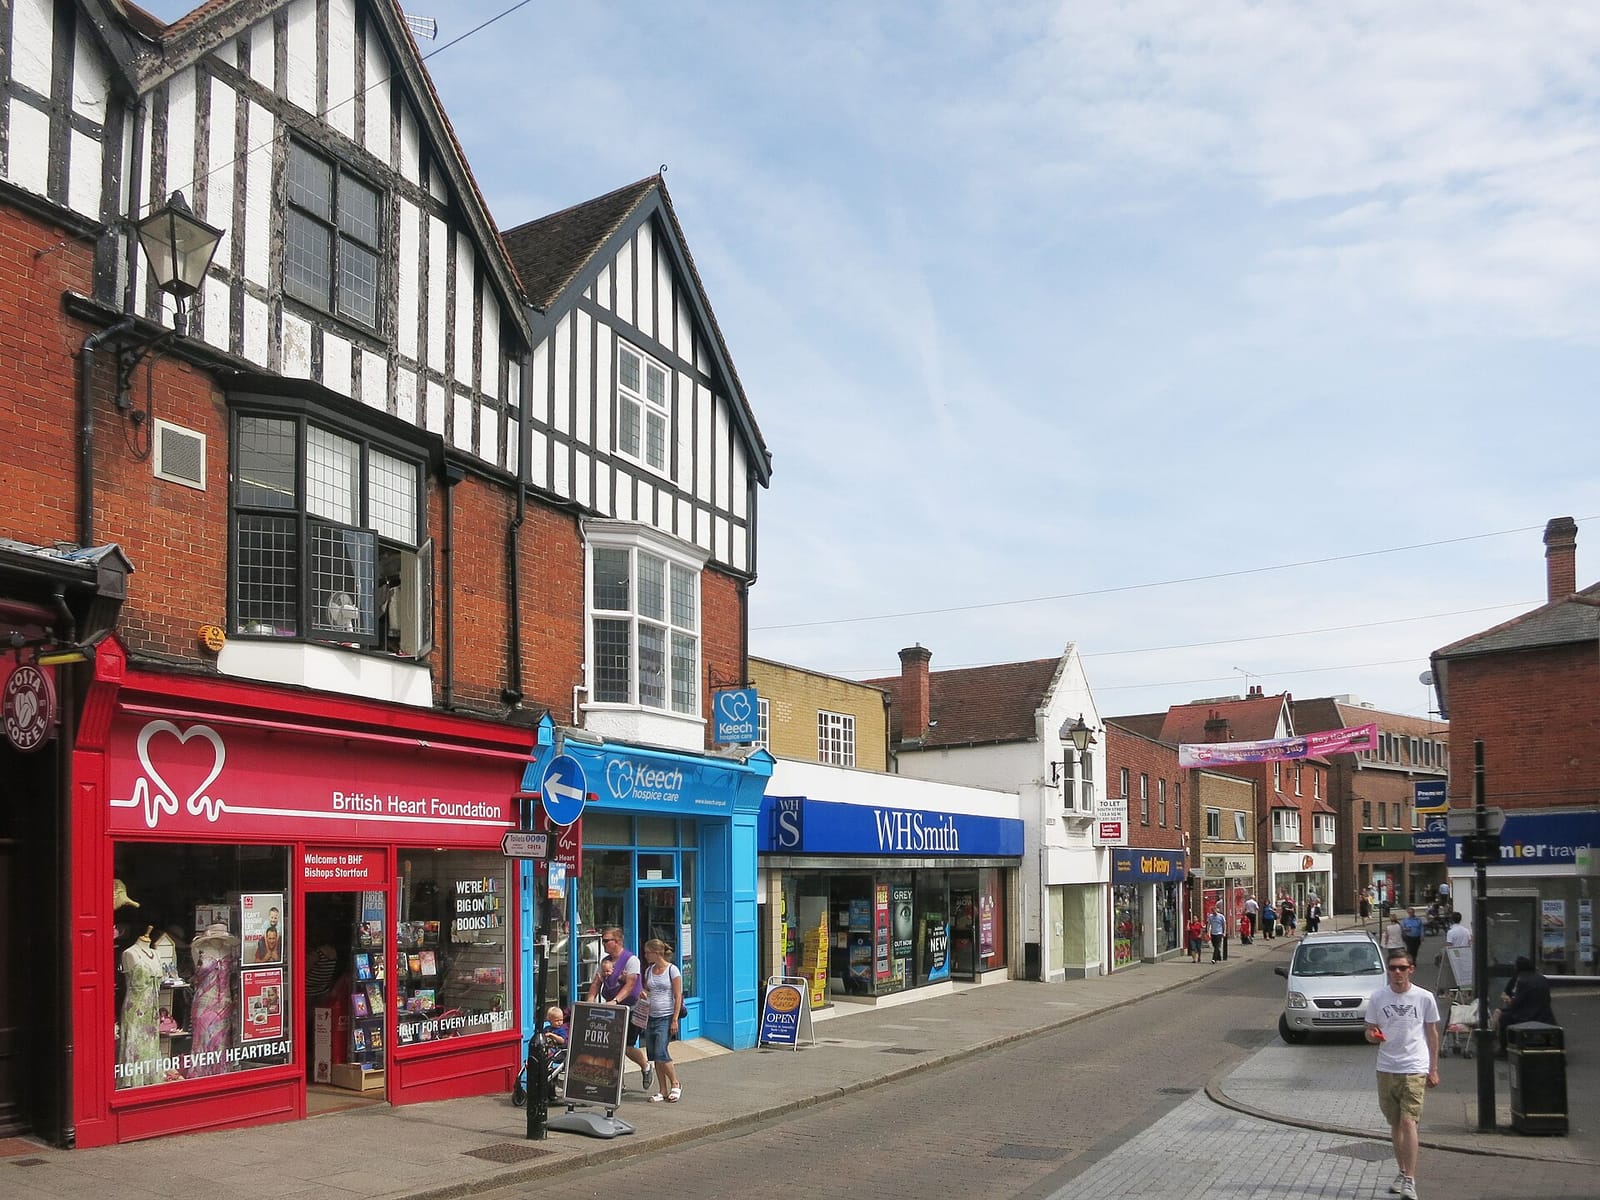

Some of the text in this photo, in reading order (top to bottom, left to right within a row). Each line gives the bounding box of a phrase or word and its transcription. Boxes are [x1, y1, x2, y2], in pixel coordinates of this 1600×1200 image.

[9, 669, 41, 694] COSTA
[7, 716, 46, 746] COFFEE
[719, 721, 753, 734] Keech
[634, 762, 683, 791] Keech
[632, 789, 679, 802] hospice care
[333, 791, 501, 818] British Heart Foundation
[780, 799, 799, 811] WH
[779, 811, 800, 846] S
[874, 809, 959, 851] WHSmith
[510, 834, 526, 842] Toilets
[304, 854, 363, 865] Welcome to BHF
[1141, 856, 1153, 874] Card
[1153, 856, 1170, 876] Factory
[304, 867, 368, 879] Bishops Stortford
[456, 880, 483, 894] WE'RE
[893, 890, 912, 900] GREY
[456, 899, 485, 912] BIG ON
[456, 917, 486, 931] BOOKS
[930, 936, 947, 953] NEW
[422, 1020, 439, 1032] FOR
[440, 1015, 467, 1031] EVERY
[468, 1009, 513, 1026] HEARTBEAT
[766, 1012, 796, 1024] OPEN
[589, 1022, 607, 1030] Pulled
[584, 1029, 610, 1044] PORK
[114, 1040, 292, 1078] FIGHT FOR EVERY HEARTBEAT
